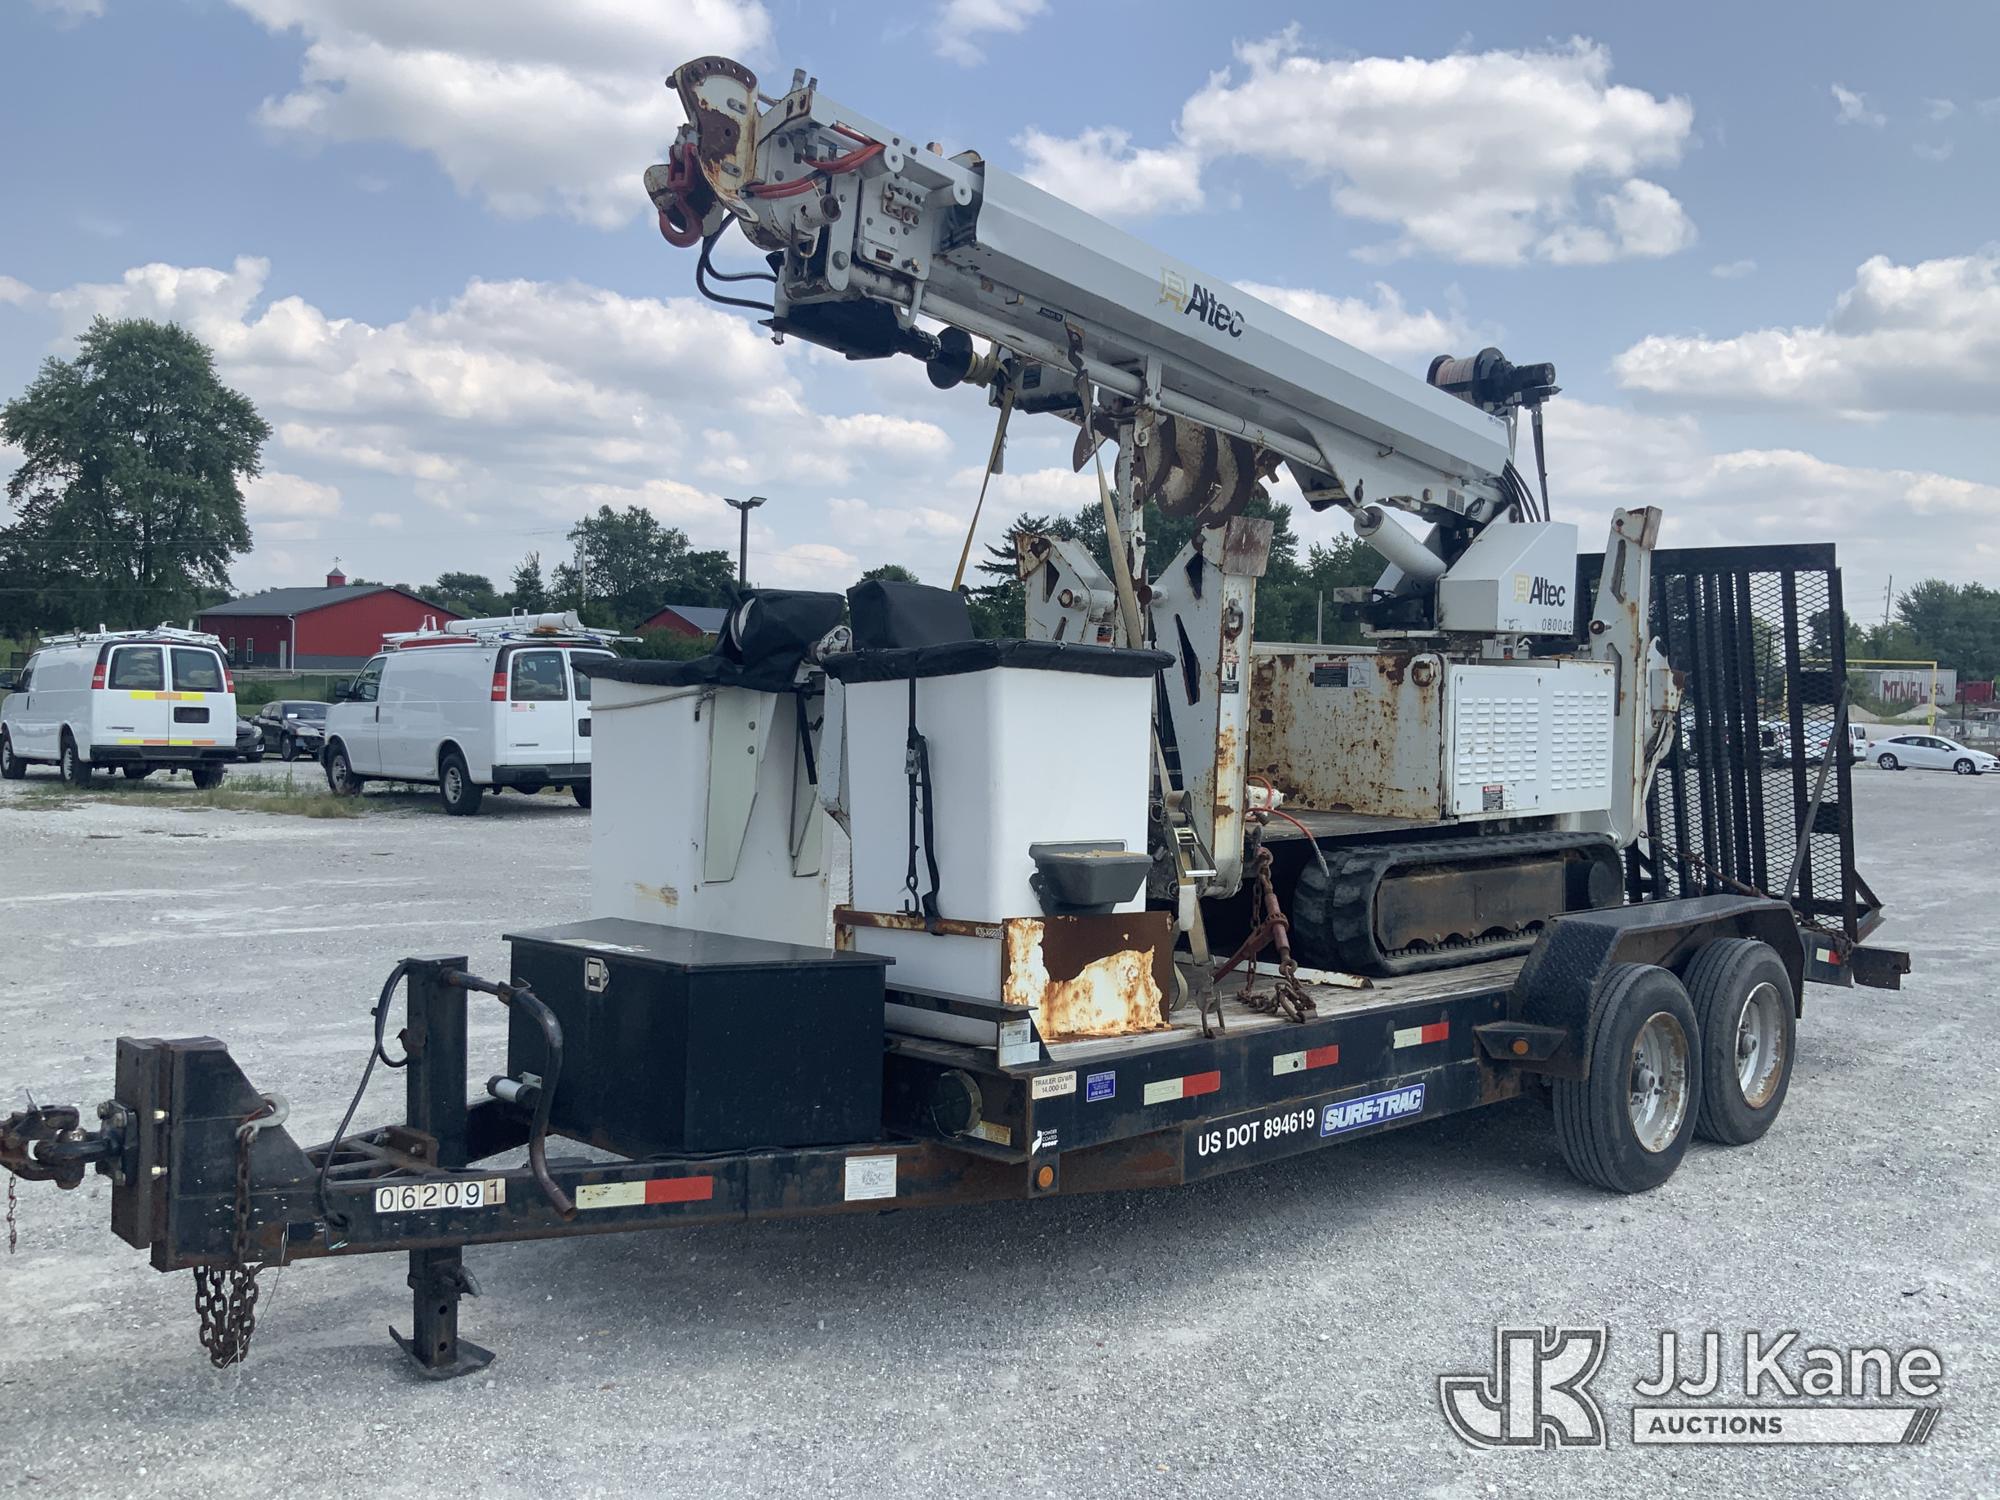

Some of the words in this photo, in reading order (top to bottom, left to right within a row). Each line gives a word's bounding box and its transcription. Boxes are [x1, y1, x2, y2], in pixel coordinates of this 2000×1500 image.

[1184, 283, 1245, 338] Altec
[1529, 576, 1566, 608] Altec
[1542, 618, 1573, 633] 080043
[1034, 1077, 1057, 1087] TRAILER
[1199, 1131, 1222, 1157] US
[1226, 1121, 1260, 1150] DOT
[1263, 1108, 1315, 1140] 894619
[380, 1181, 499, 1209] 062091
